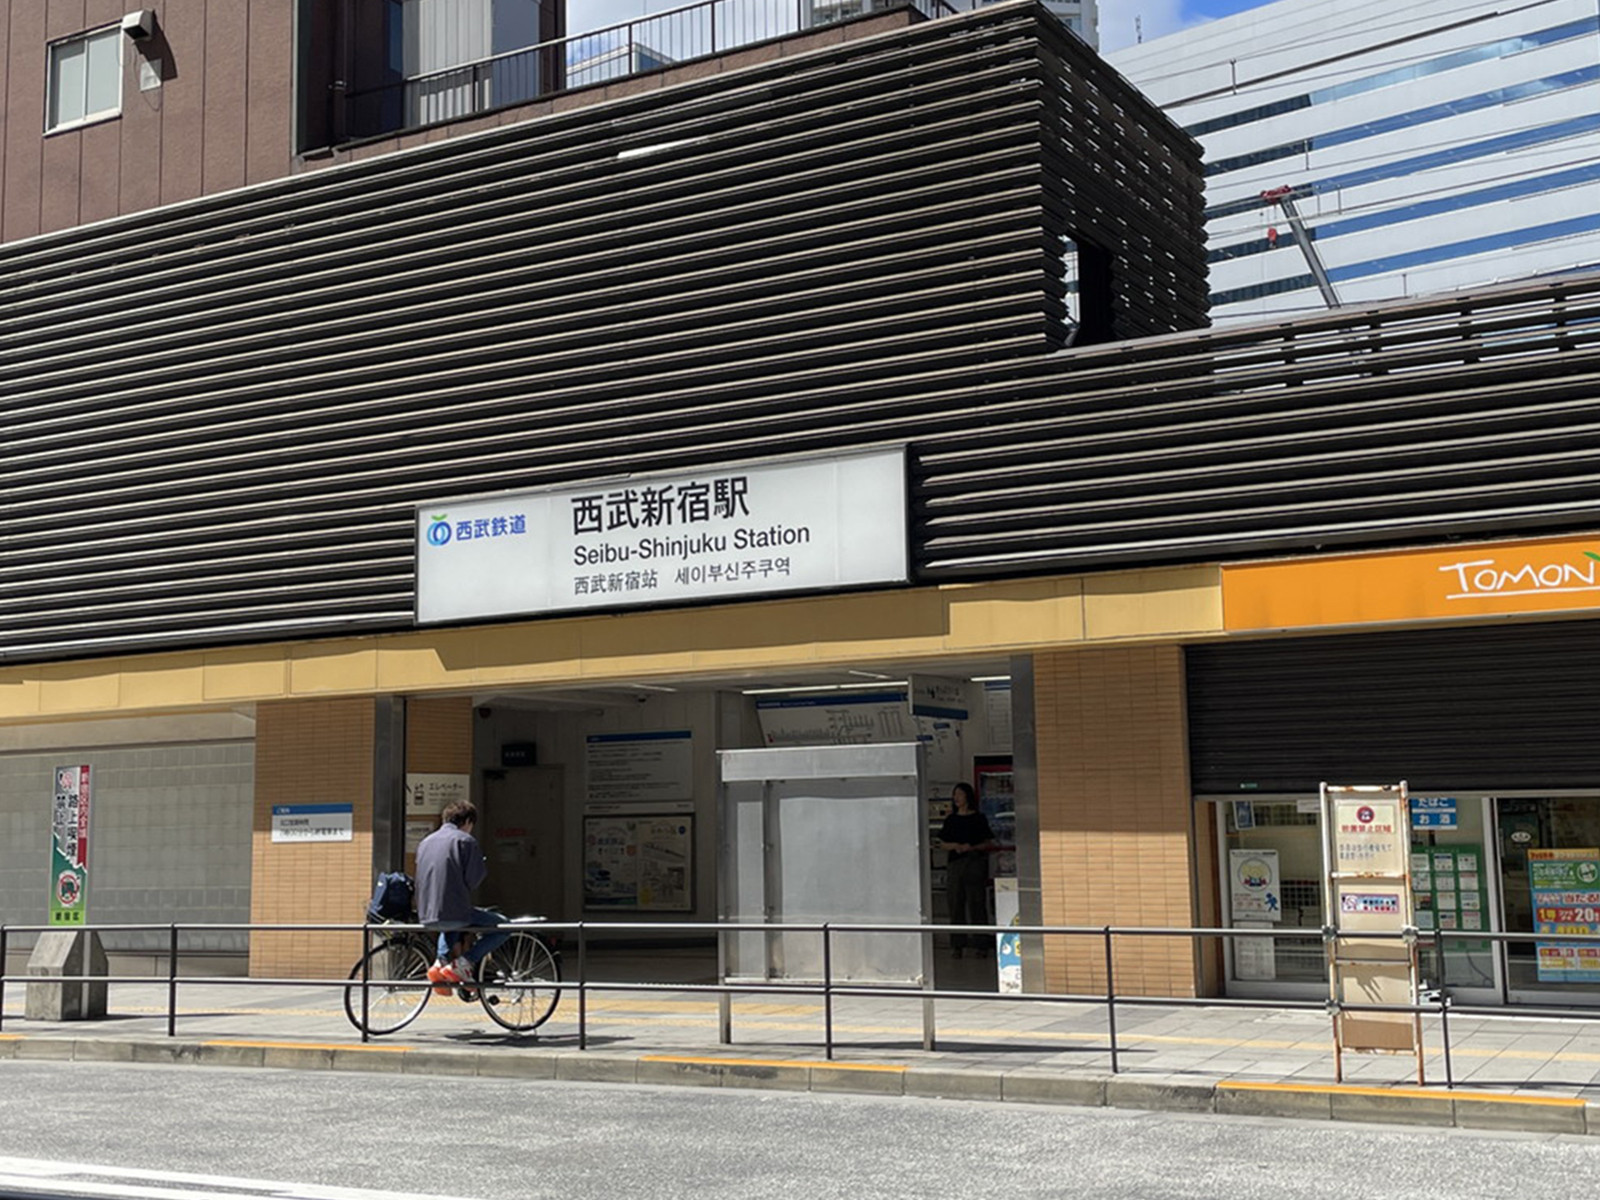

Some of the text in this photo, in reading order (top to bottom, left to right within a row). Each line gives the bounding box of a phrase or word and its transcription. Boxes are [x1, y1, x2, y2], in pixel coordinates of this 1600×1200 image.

[572, 476, 749, 535] 西武新宿駅
[456, 514, 526, 541] 西武鉄道
[574, 525, 810, 566] Seibu-Shinjuku Station
[573, 570, 658, 595] 西武新宿站
[674, 557, 791, 585] 세이부신주쿠역
[429, 782, 464, 791] エレベーター
